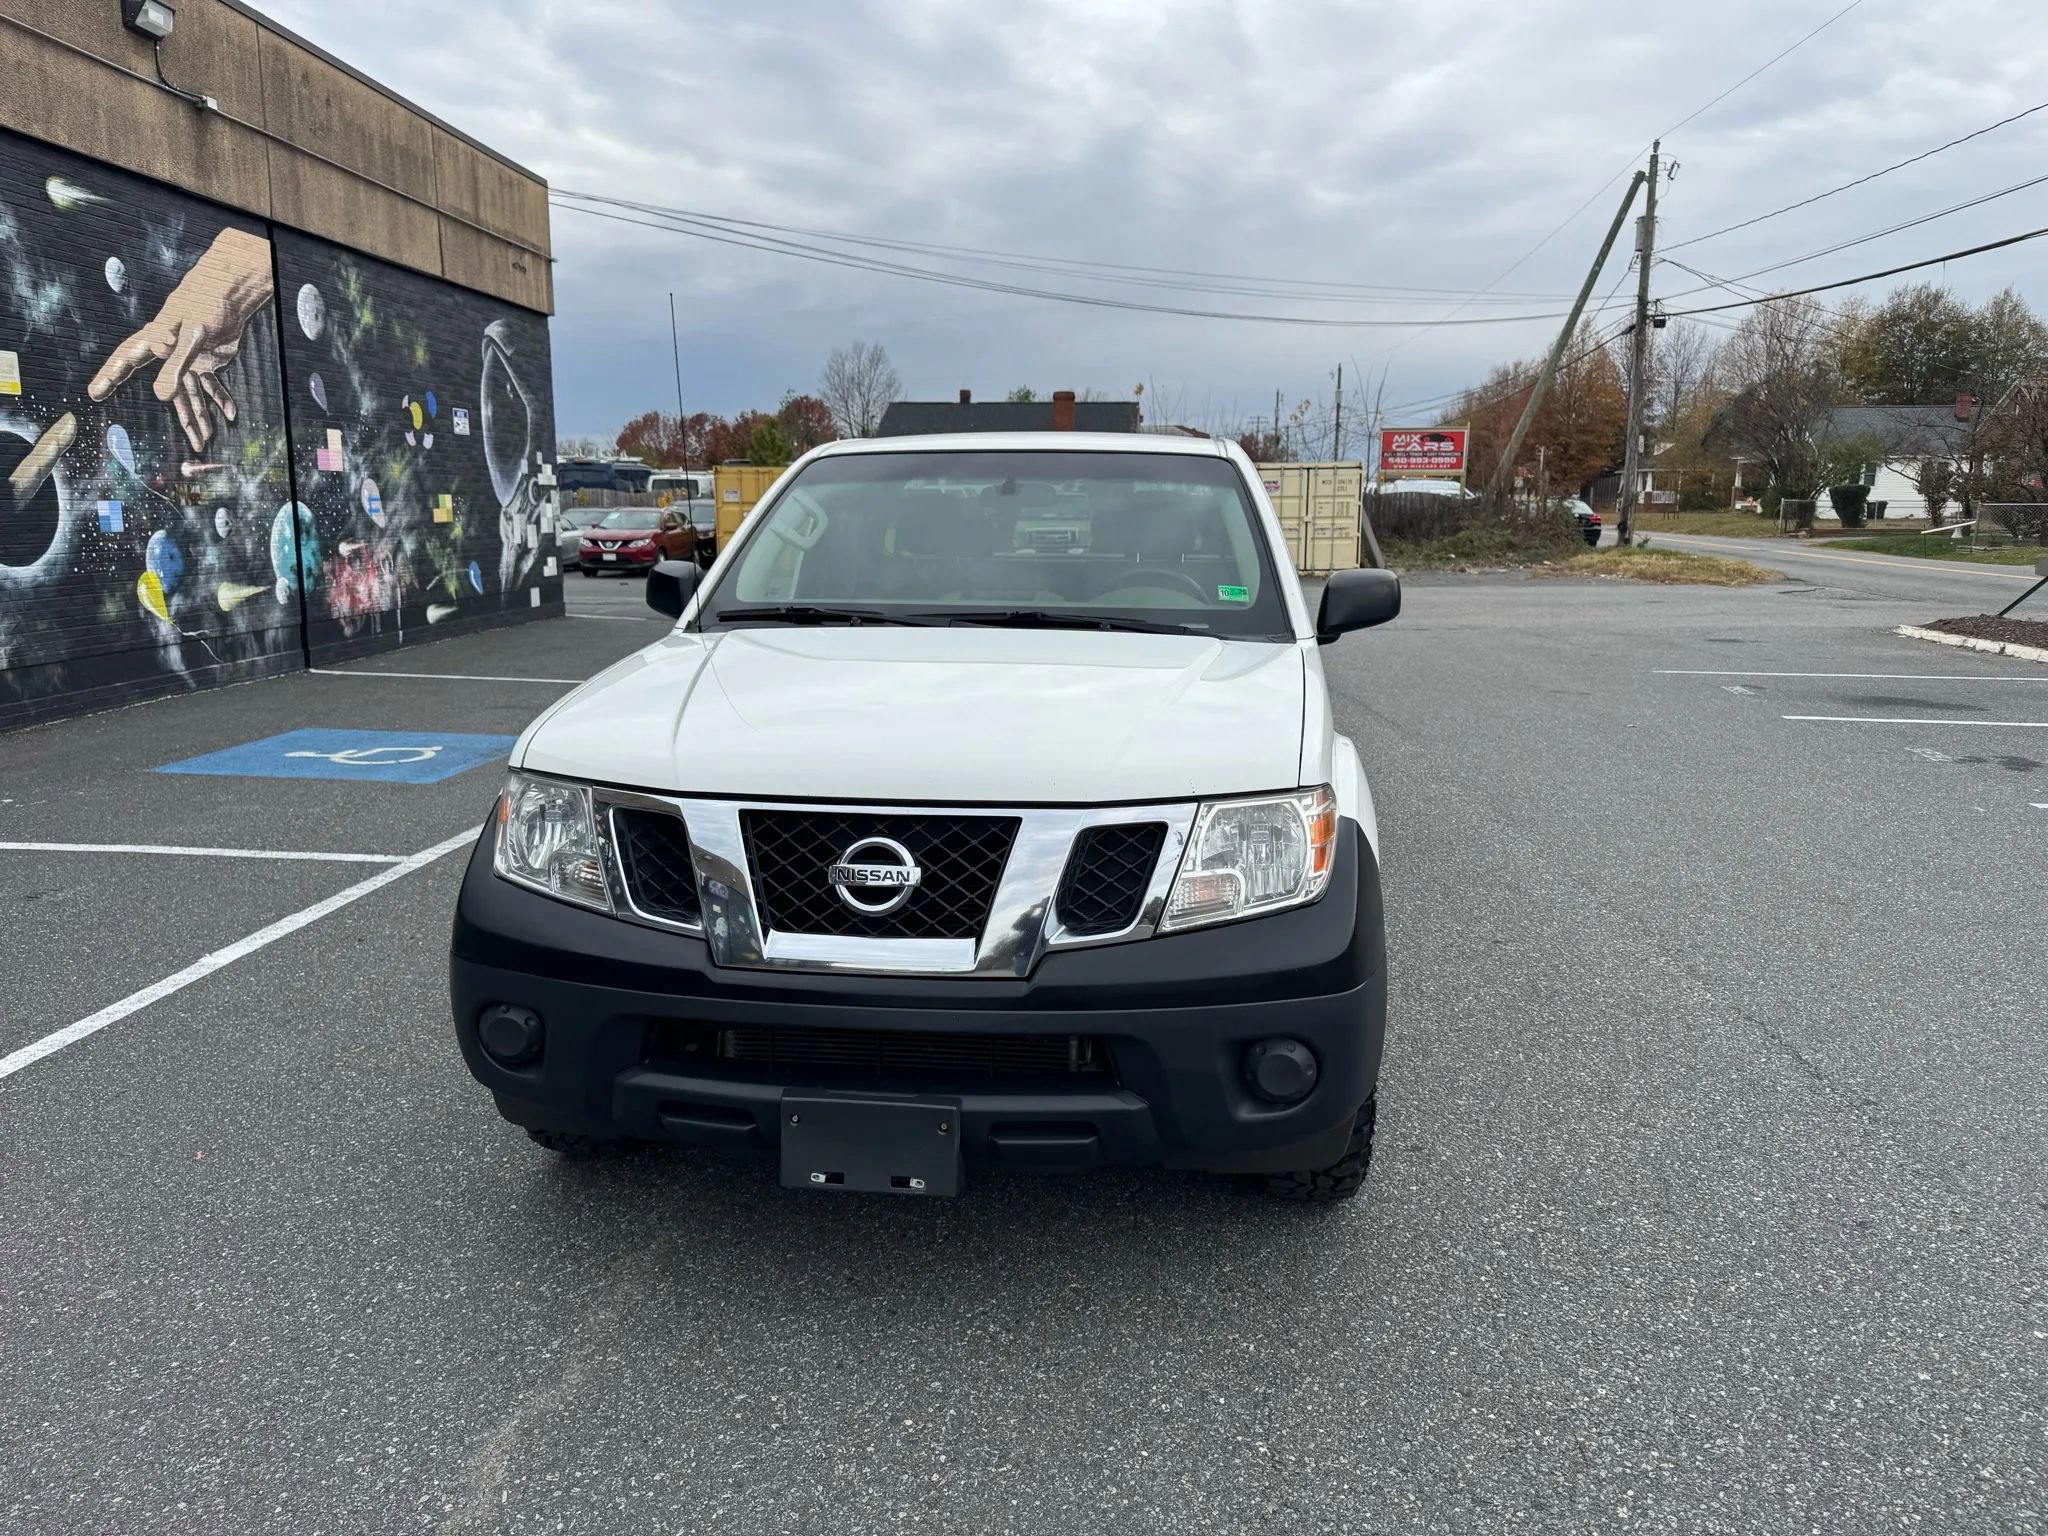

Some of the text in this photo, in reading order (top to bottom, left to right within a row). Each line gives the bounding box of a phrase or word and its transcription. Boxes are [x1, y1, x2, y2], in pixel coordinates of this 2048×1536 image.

[1393, 434, 1421, 442] MIX
[1392, 442, 1455, 451] CARS
[1221, 589, 1230, 597] 10
[837, 868, 910, 882] NISSAN
